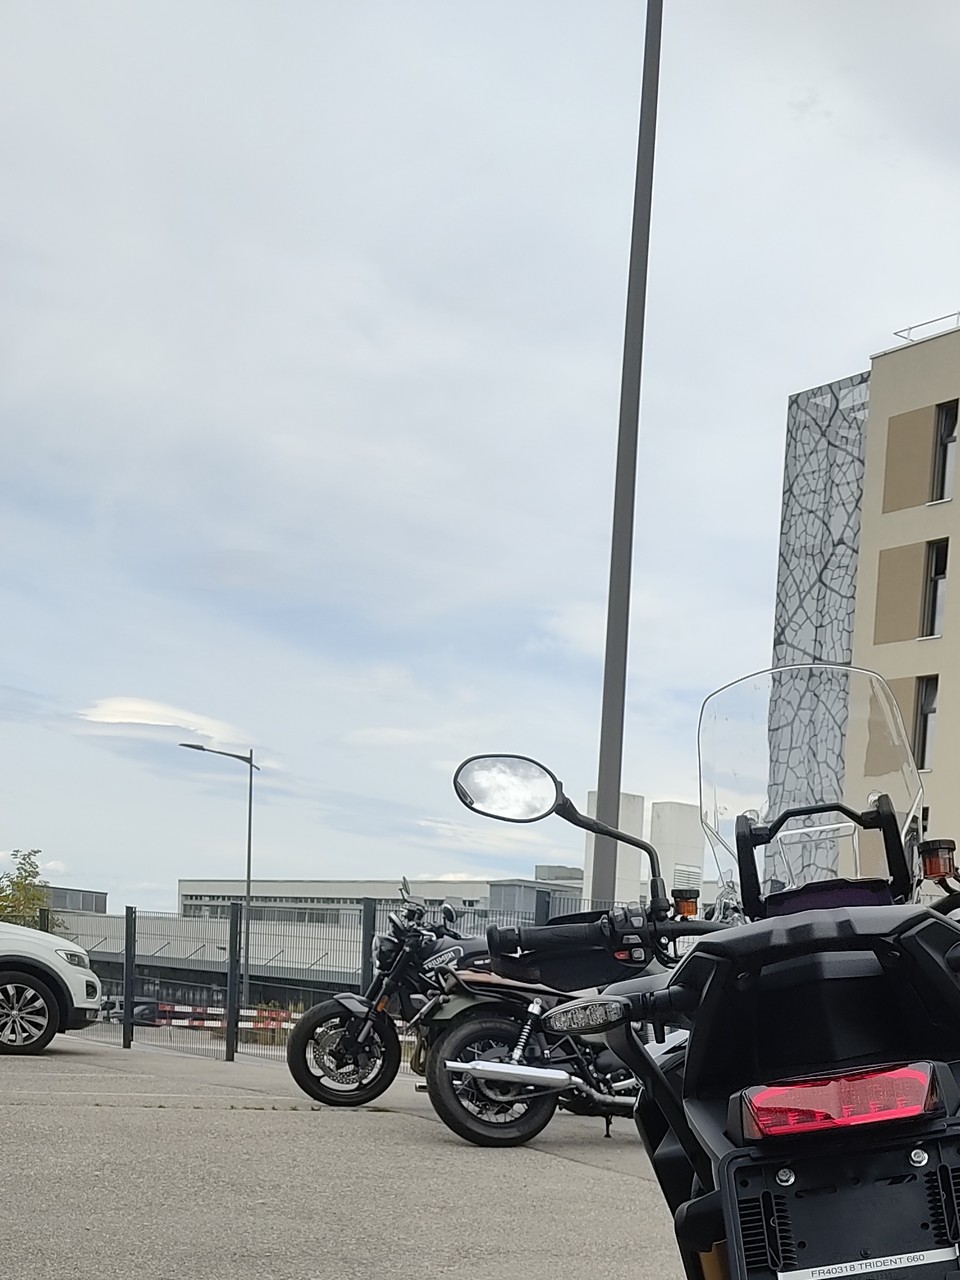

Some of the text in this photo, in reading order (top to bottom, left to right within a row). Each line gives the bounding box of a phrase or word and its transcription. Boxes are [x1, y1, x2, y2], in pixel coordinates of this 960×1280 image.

[422, 951, 455, 970] TRIUMPH
[811, 1253, 925, 1278] FR40318 TRIDENT 660
